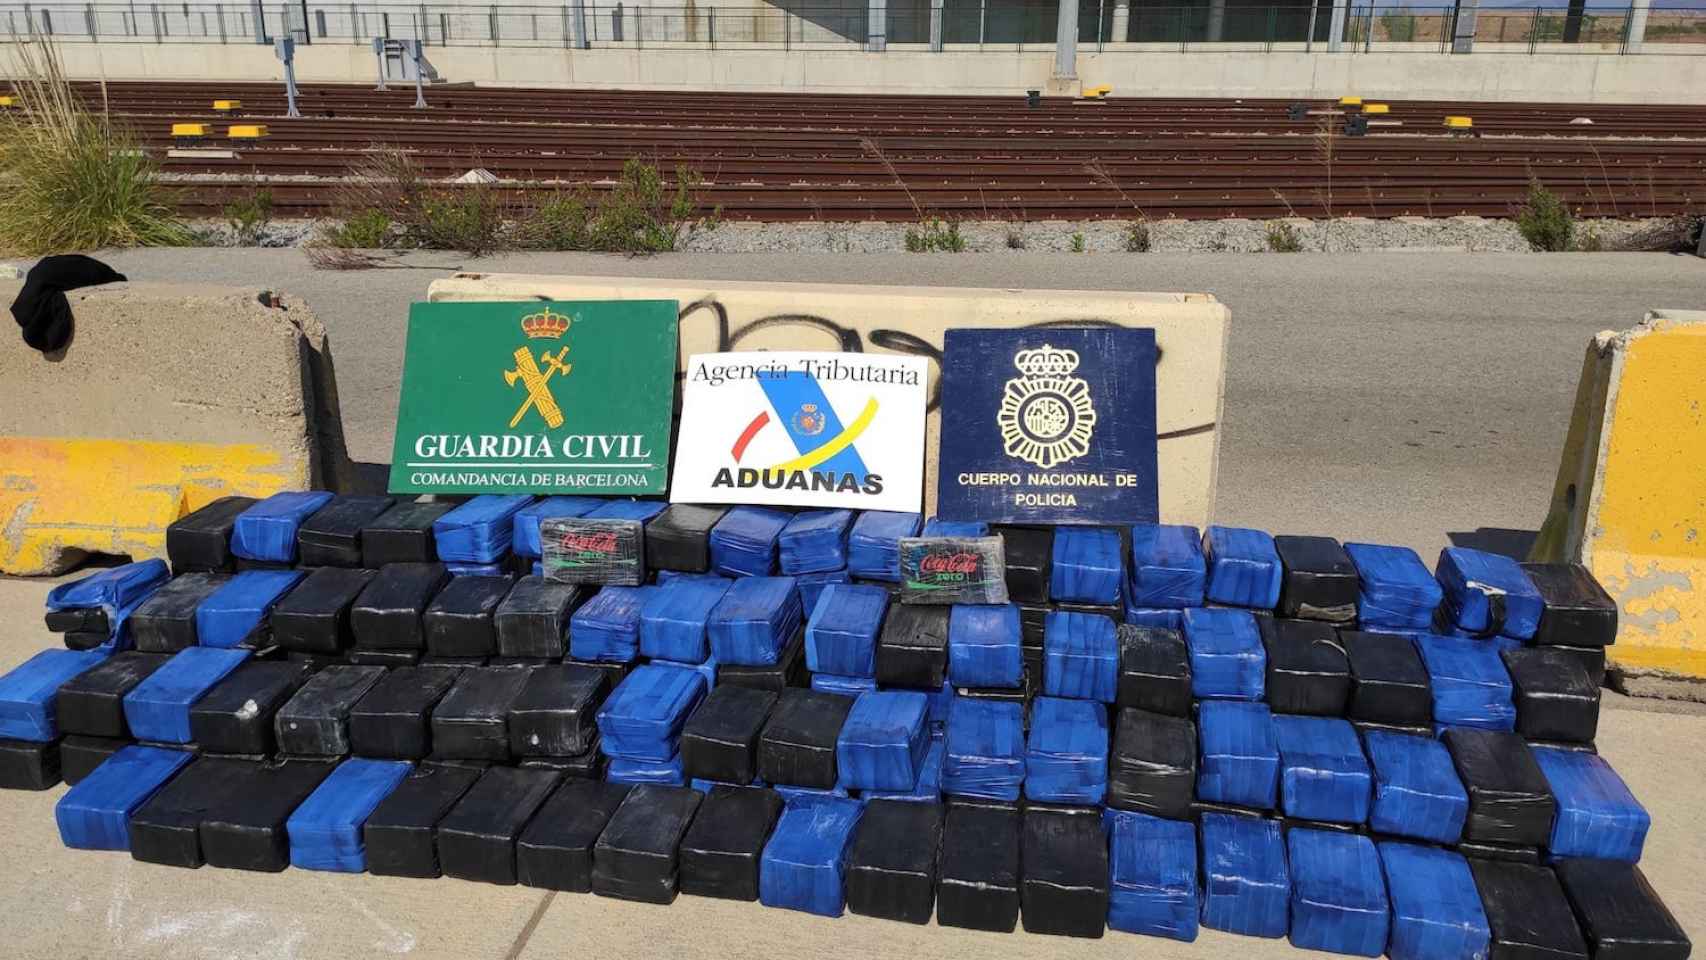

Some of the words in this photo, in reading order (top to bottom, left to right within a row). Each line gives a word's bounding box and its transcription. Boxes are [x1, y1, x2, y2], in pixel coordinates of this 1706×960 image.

[693, 359, 788, 386] Agencia
[799, 359, 919, 386] Tributaria
[415, 434, 554, 459] GUARDIA
[562, 435, 651, 459] CIVIL
[411, 472, 527, 487] COMANDANCIA
[531, 473, 551, 487] DE
[555, 473, 649, 488] BARCELONA
[711, 467, 884, 495] ADUANAS
[958, 473, 1021, 486] CUERPO
[1027, 473, 1108, 486] NACIONAL
[1115, 474, 1137, 487] DE
[1015, 493, 1077, 506] POLICIA
[920, 553, 977, 573] Coca-Cola
